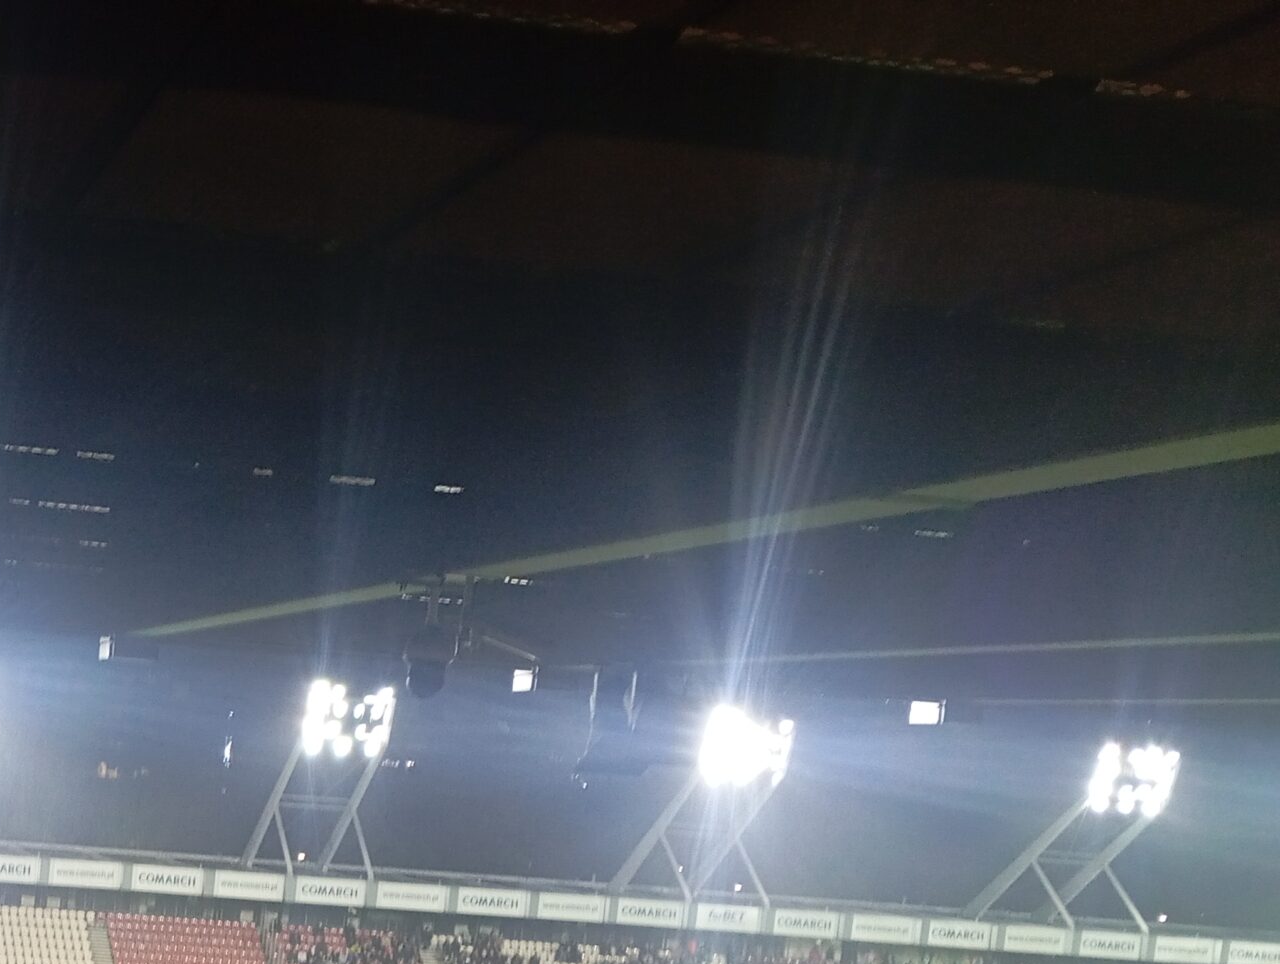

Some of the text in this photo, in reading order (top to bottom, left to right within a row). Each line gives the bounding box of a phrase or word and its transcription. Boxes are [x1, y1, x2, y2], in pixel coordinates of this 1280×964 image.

[138, 872, 197, 888] COMARCH
[301, 884, 359, 900] COMARCH
[462, 894, 519, 910] COMARCH
[621, 905, 677, 919] COMARCH
[777, 916, 832, 931] COMARCH
[932, 927, 984, 942] COMARCH
[1083, 938, 1135, 953] COMARCH
